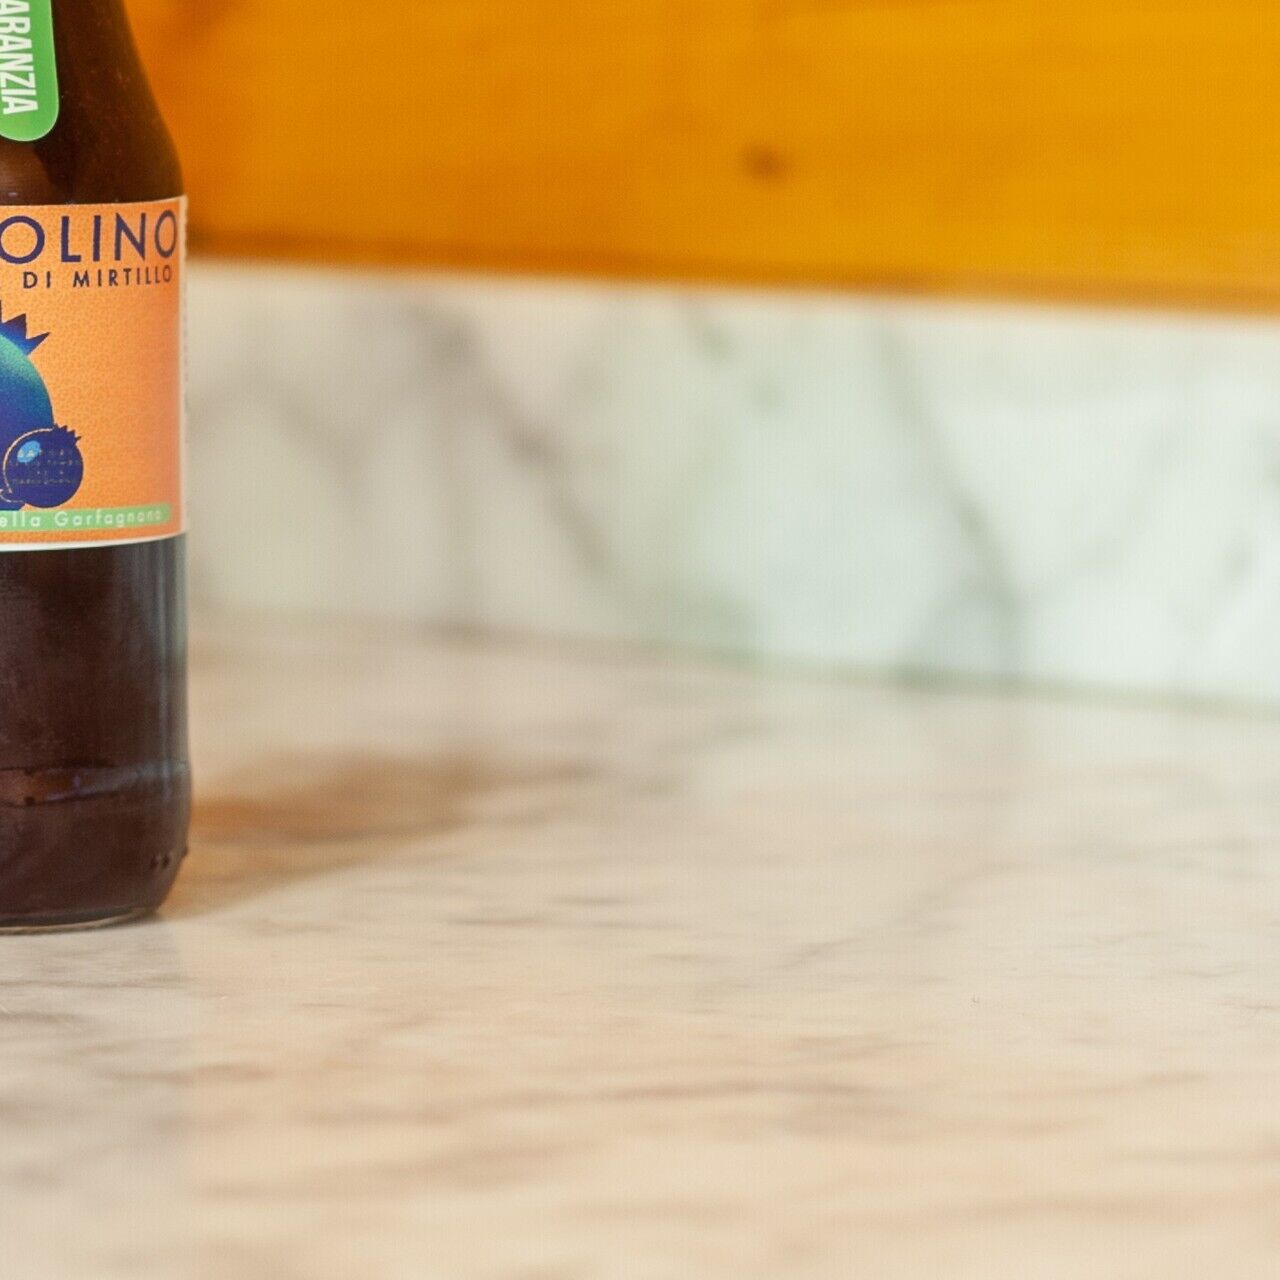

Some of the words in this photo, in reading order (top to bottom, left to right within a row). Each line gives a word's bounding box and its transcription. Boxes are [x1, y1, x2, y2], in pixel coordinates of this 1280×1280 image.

[23, 272, 52, 289] DI
[73, 266, 173, 288] MIRTILLO
[54, 508, 162, 528] Garfagnana
